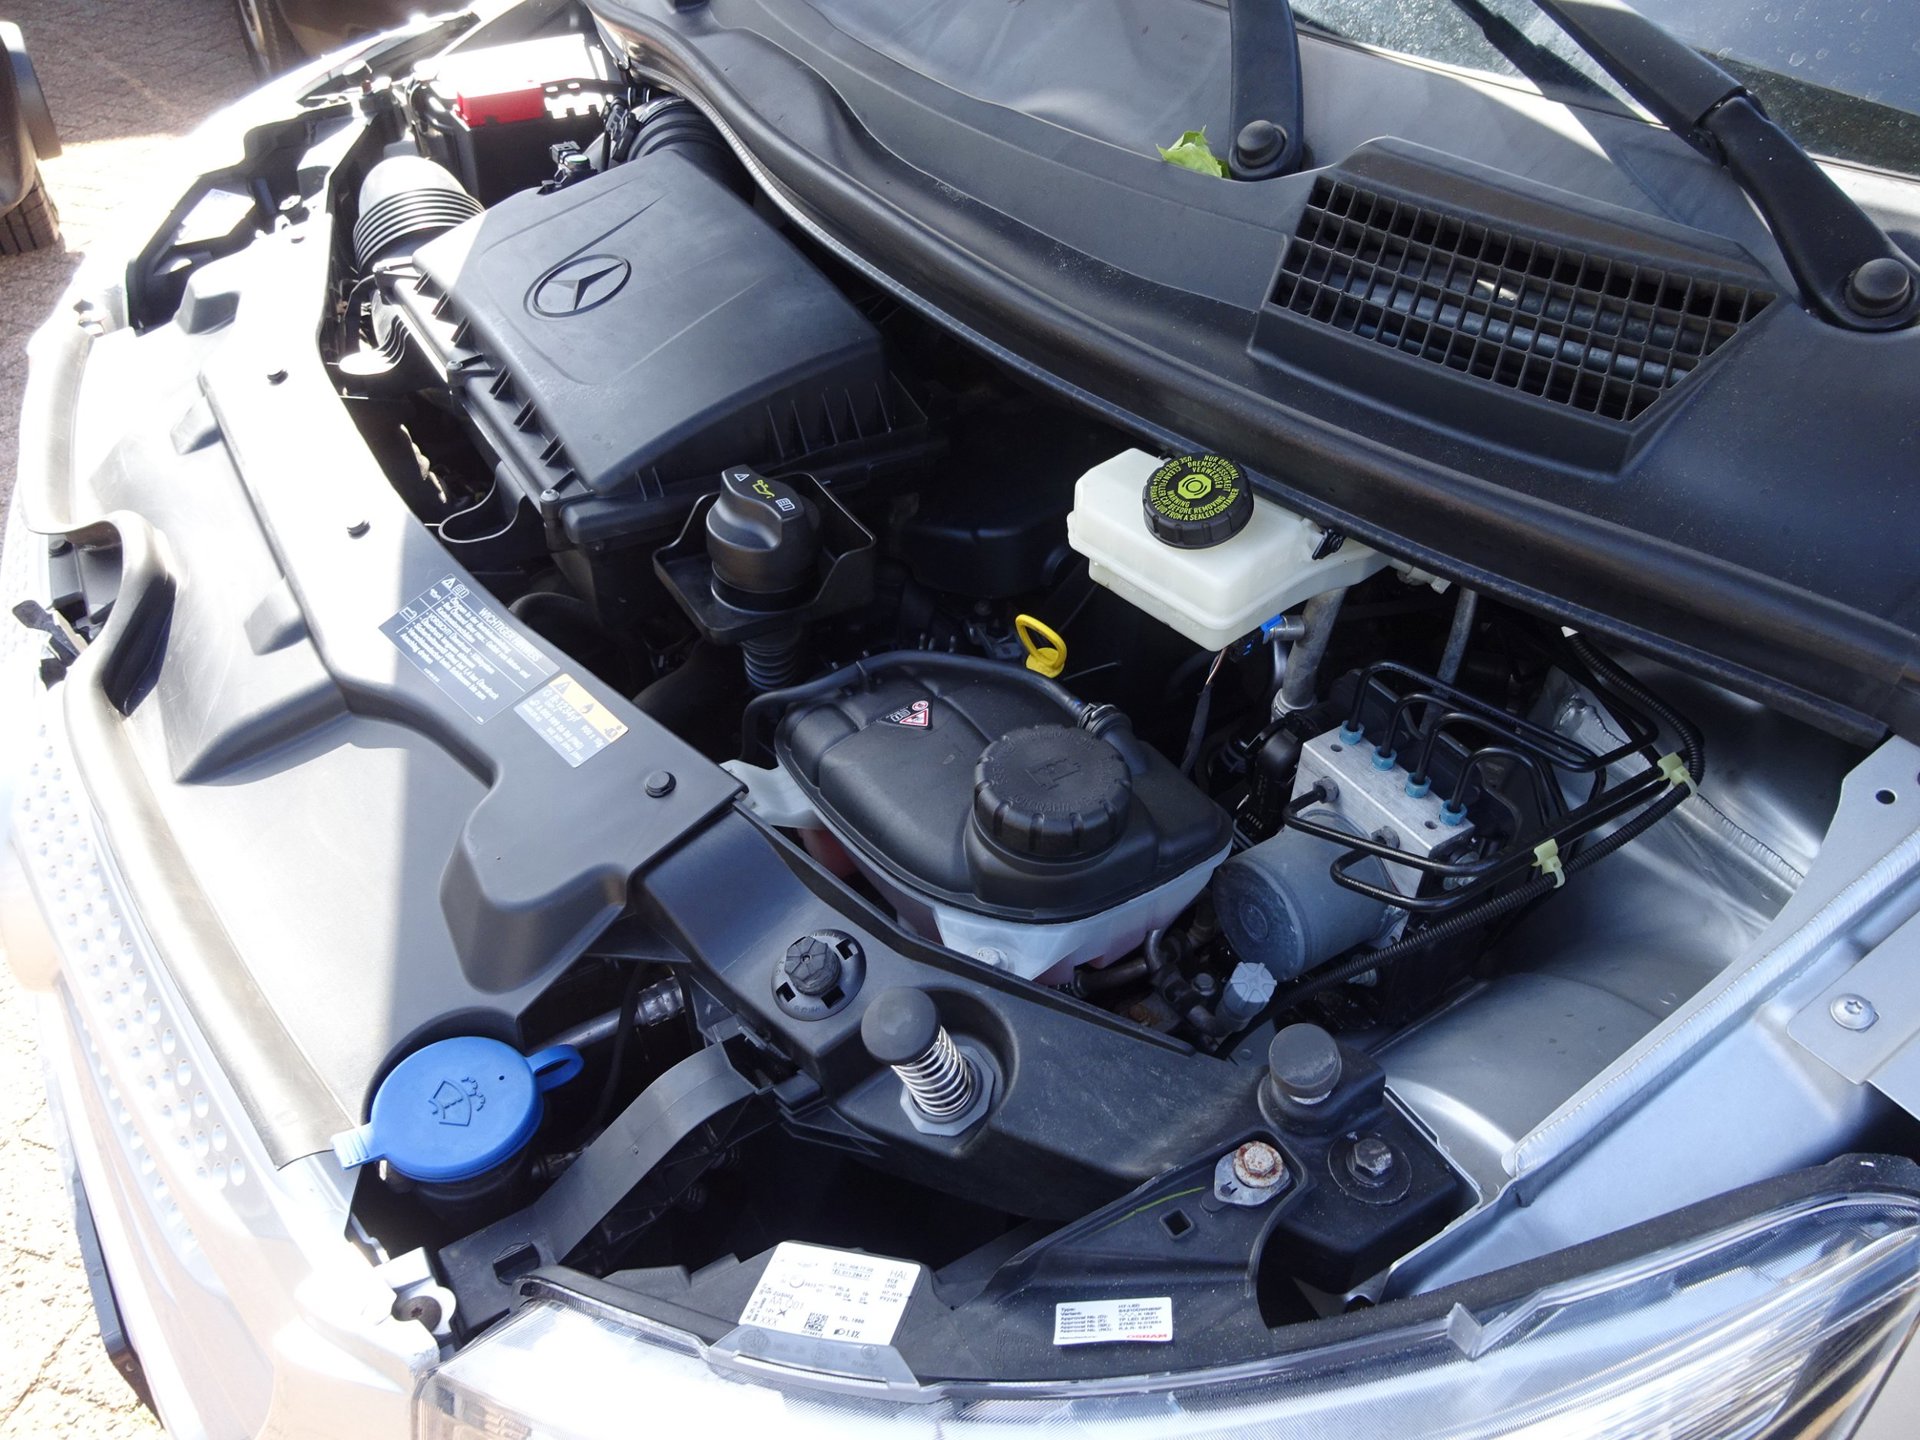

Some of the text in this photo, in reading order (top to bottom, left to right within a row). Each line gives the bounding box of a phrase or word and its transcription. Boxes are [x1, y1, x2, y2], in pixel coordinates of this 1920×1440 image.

[1164, 460, 1180, 471] ONLY
[1179, 456, 1192, 464] USE
[1218, 459, 1239, 480] ORIGINAL
[1192, 468, 1223, 488] VERWENDEN
[1150, 486, 1159, 501] BRAKE
[1158, 466, 1226, 514] CLEAN FILLER CAP BEFORE REMOVING
[1167, 490, 1190, 507] WARNING
[1153, 500, 1168, 514] FLUID
[1214, 488, 1239, 513] CONTAINER
[1166, 510, 1182, 520] FROM
[1190, 510, 1214, 520] SEALED
[419, 618, 444, 639] Überdruck
[476, 607, 542, 662] WICHTIGER HINWEIS
[448, 632, 473, 653] Überdruck
[545, 693, 582, 725] R-1234yf
